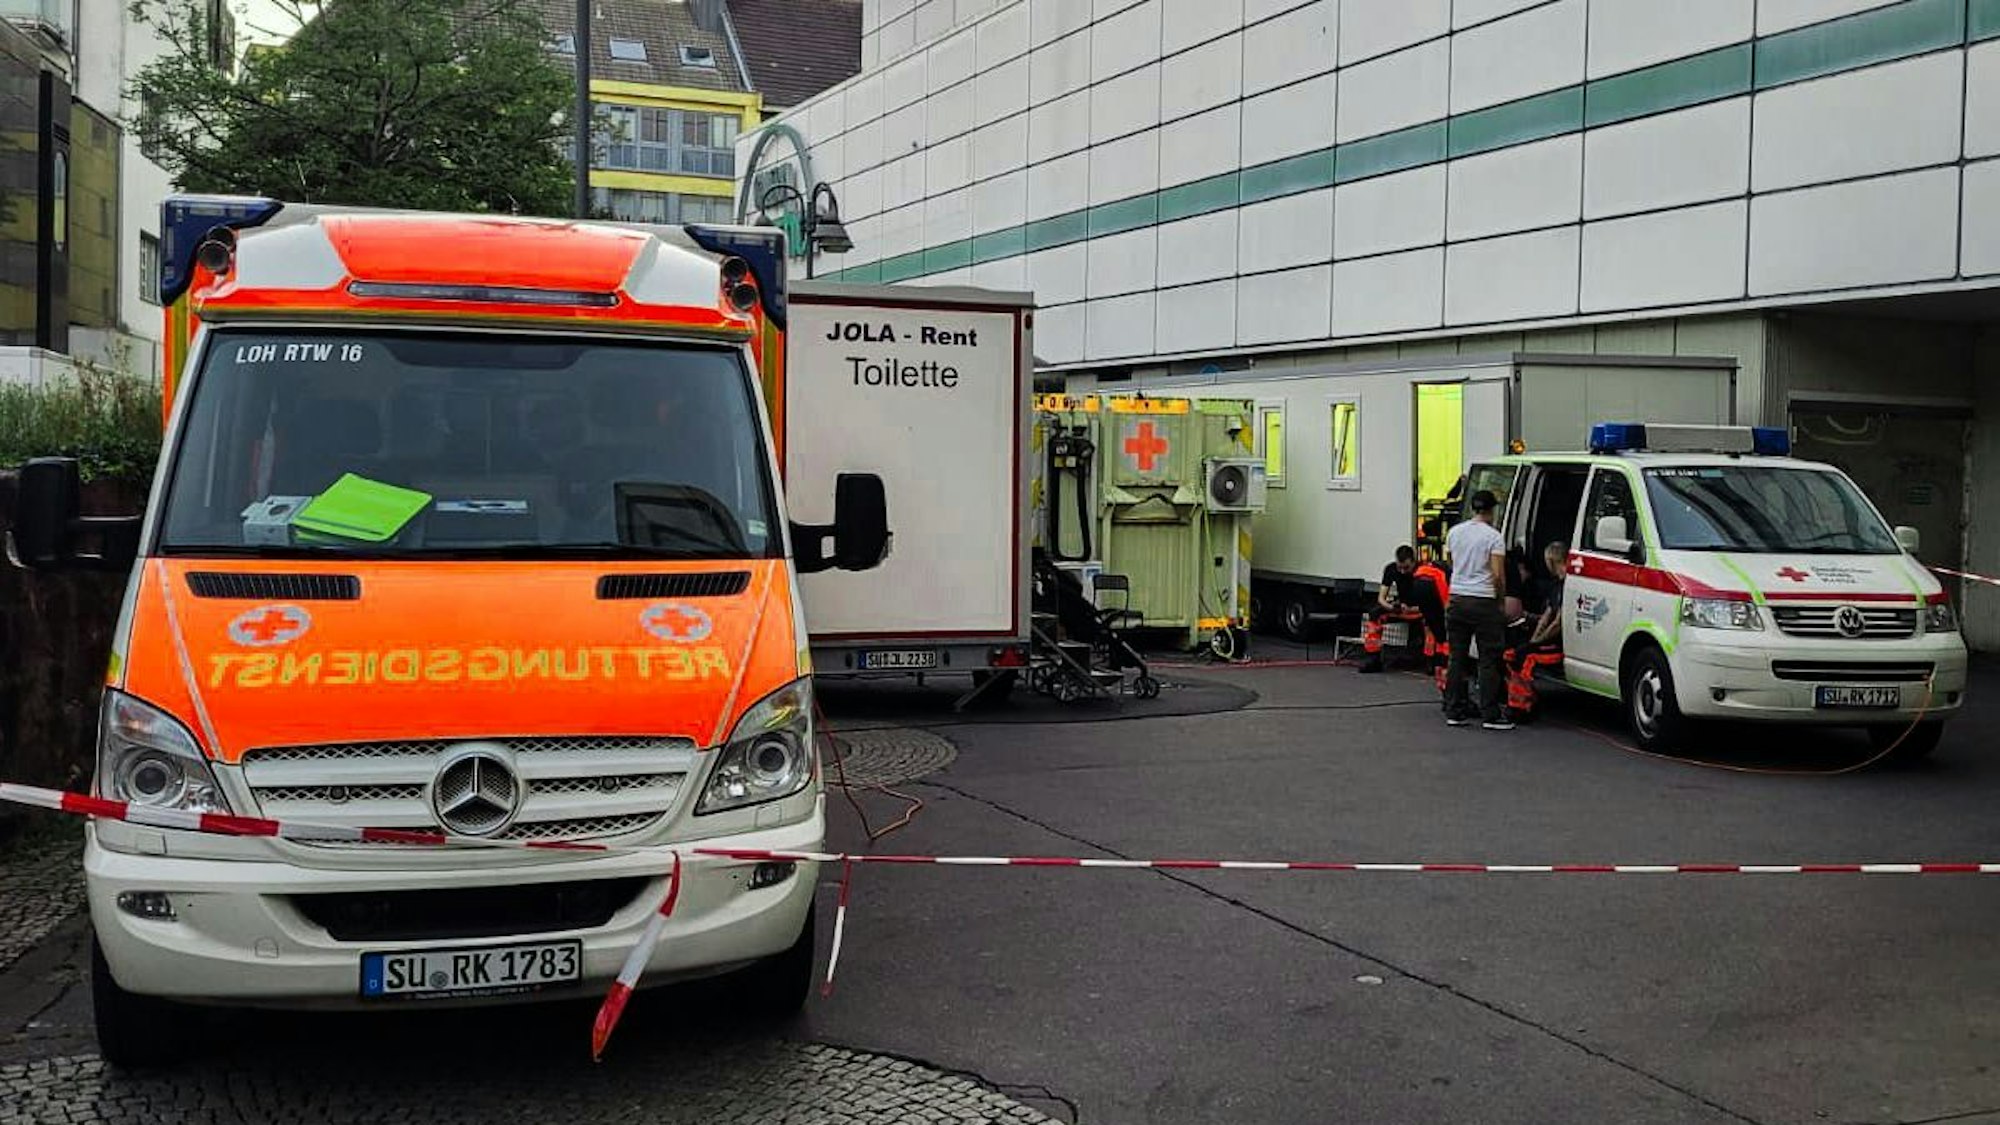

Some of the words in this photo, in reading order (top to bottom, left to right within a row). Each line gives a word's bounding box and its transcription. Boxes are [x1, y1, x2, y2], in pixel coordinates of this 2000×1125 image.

[826, 322, 896, 342] JOLA
[921, 326, 978, 347] Rent
[235, 344, 278, 363] LOH
[283, 343, 334, 362] RTW
[340, 343, 363, 362] 16
[845, 356, 959, 388] Toilette
[1850, 687, 1868, 704] RK
[386, 957, 427, 989] SU
[453, 953, 492, 986] RK
[500, 946, 577, 981] 1783
